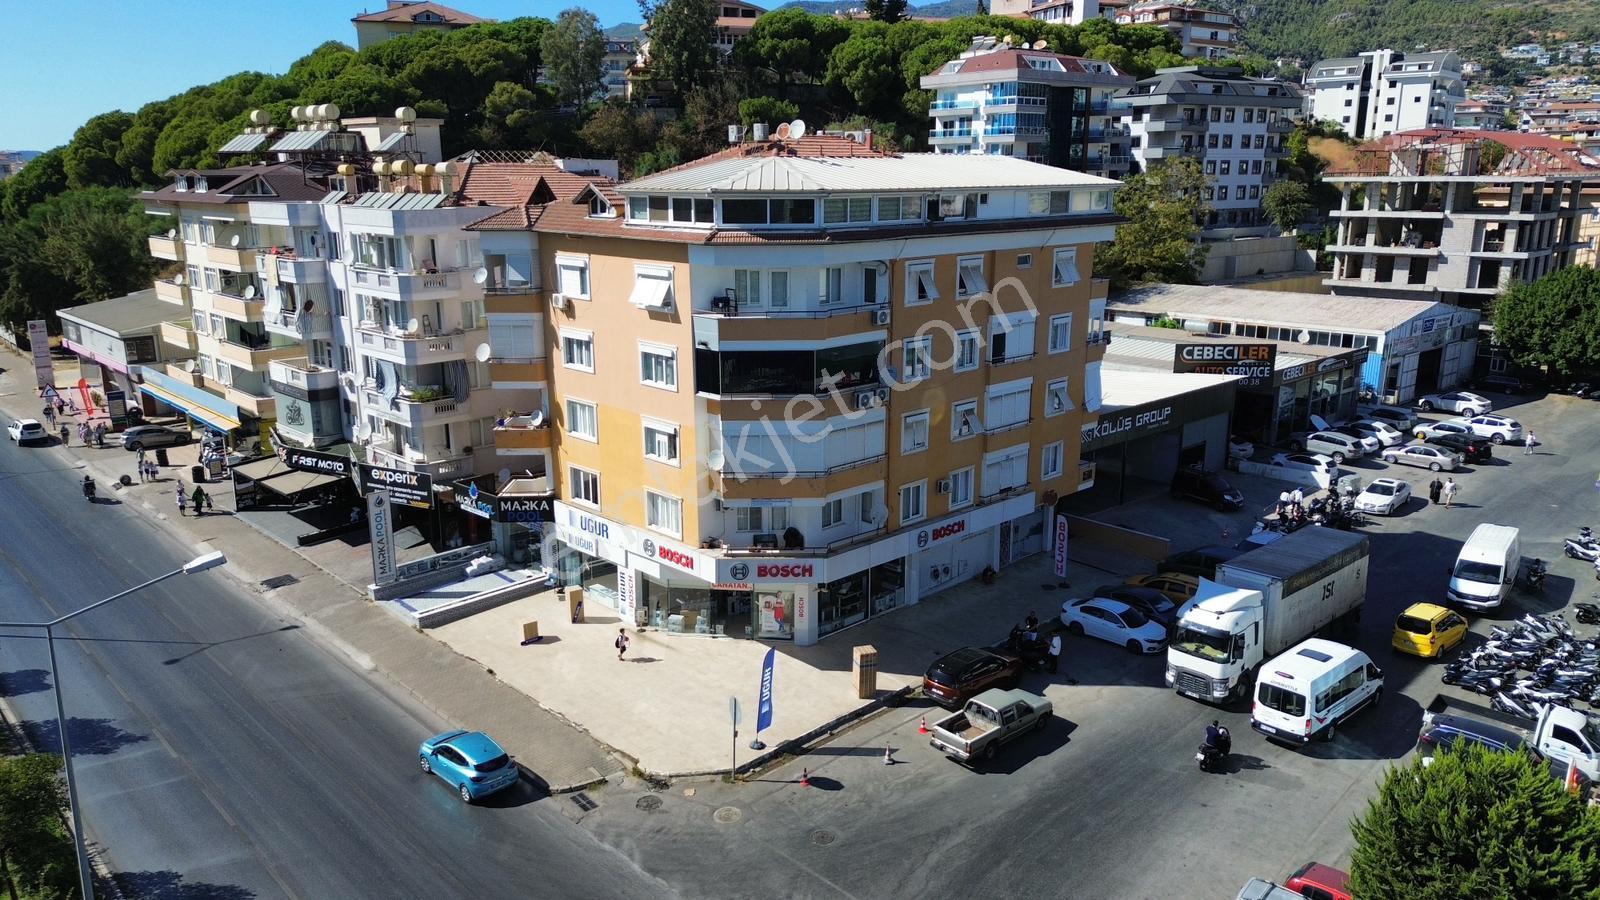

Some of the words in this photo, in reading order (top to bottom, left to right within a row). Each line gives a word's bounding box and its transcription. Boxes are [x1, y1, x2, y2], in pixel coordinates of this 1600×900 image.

[1135, 407, 1171, 426] GROUP
[318, 459, 344, 471] MOTO
[371, 468, 418, 486] experix
[501, 500, 550, 511] MARKA
[374, 509, 385, 538] POOL
[507, 512, 544, 522] POOL
[932, 519, 965, 542] BOSCH
[376, 538, 388, 576] MARKA
[659, 545, 694, 570] BOSCH
[1056, 521, 1066, 575] BOSCH
[757, 563, 813, 578] BOSCH
